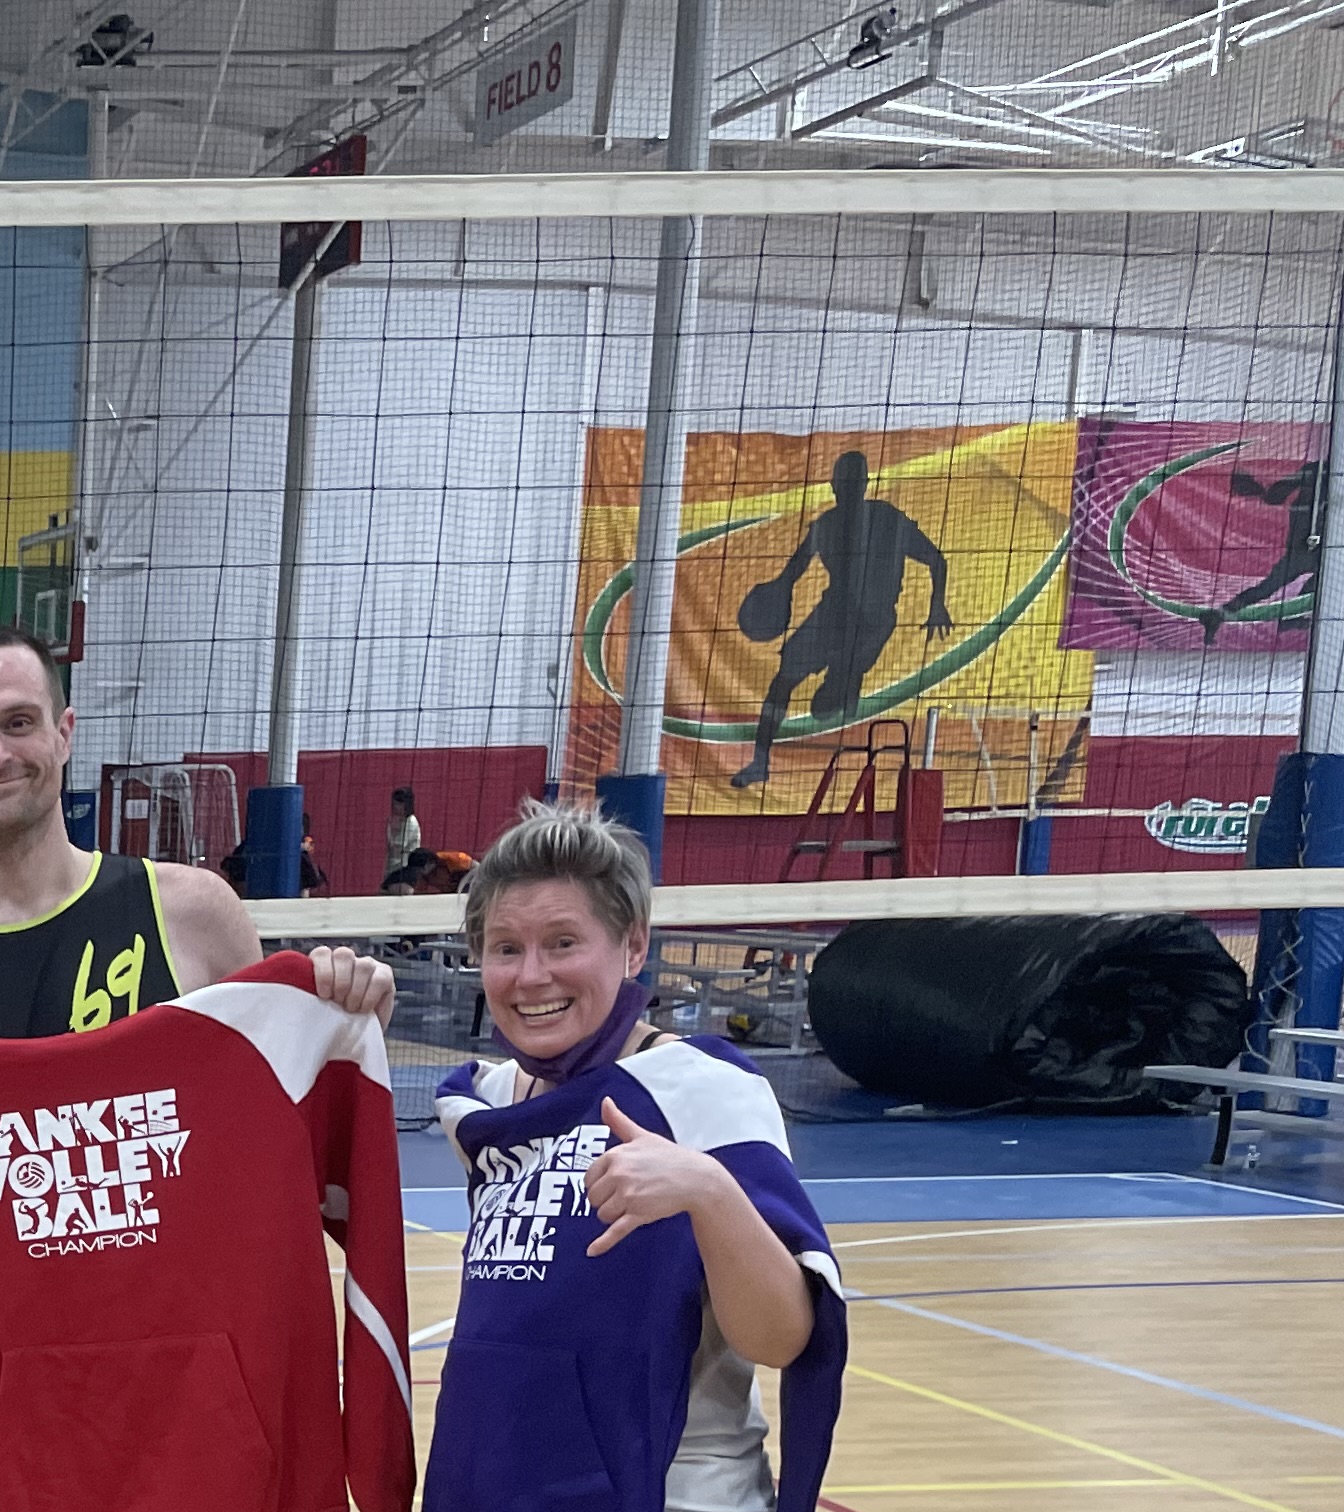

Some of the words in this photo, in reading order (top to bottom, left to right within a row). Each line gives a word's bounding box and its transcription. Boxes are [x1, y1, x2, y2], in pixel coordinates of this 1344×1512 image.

[485, 60, 542, 121] FIELD
[545, 41, 562, 93] 8
[69, 932, 146, 1034] 69
[11, 1183, 161, 1242] BALL
[27, 1228, 158, 1259] CHAMPION
